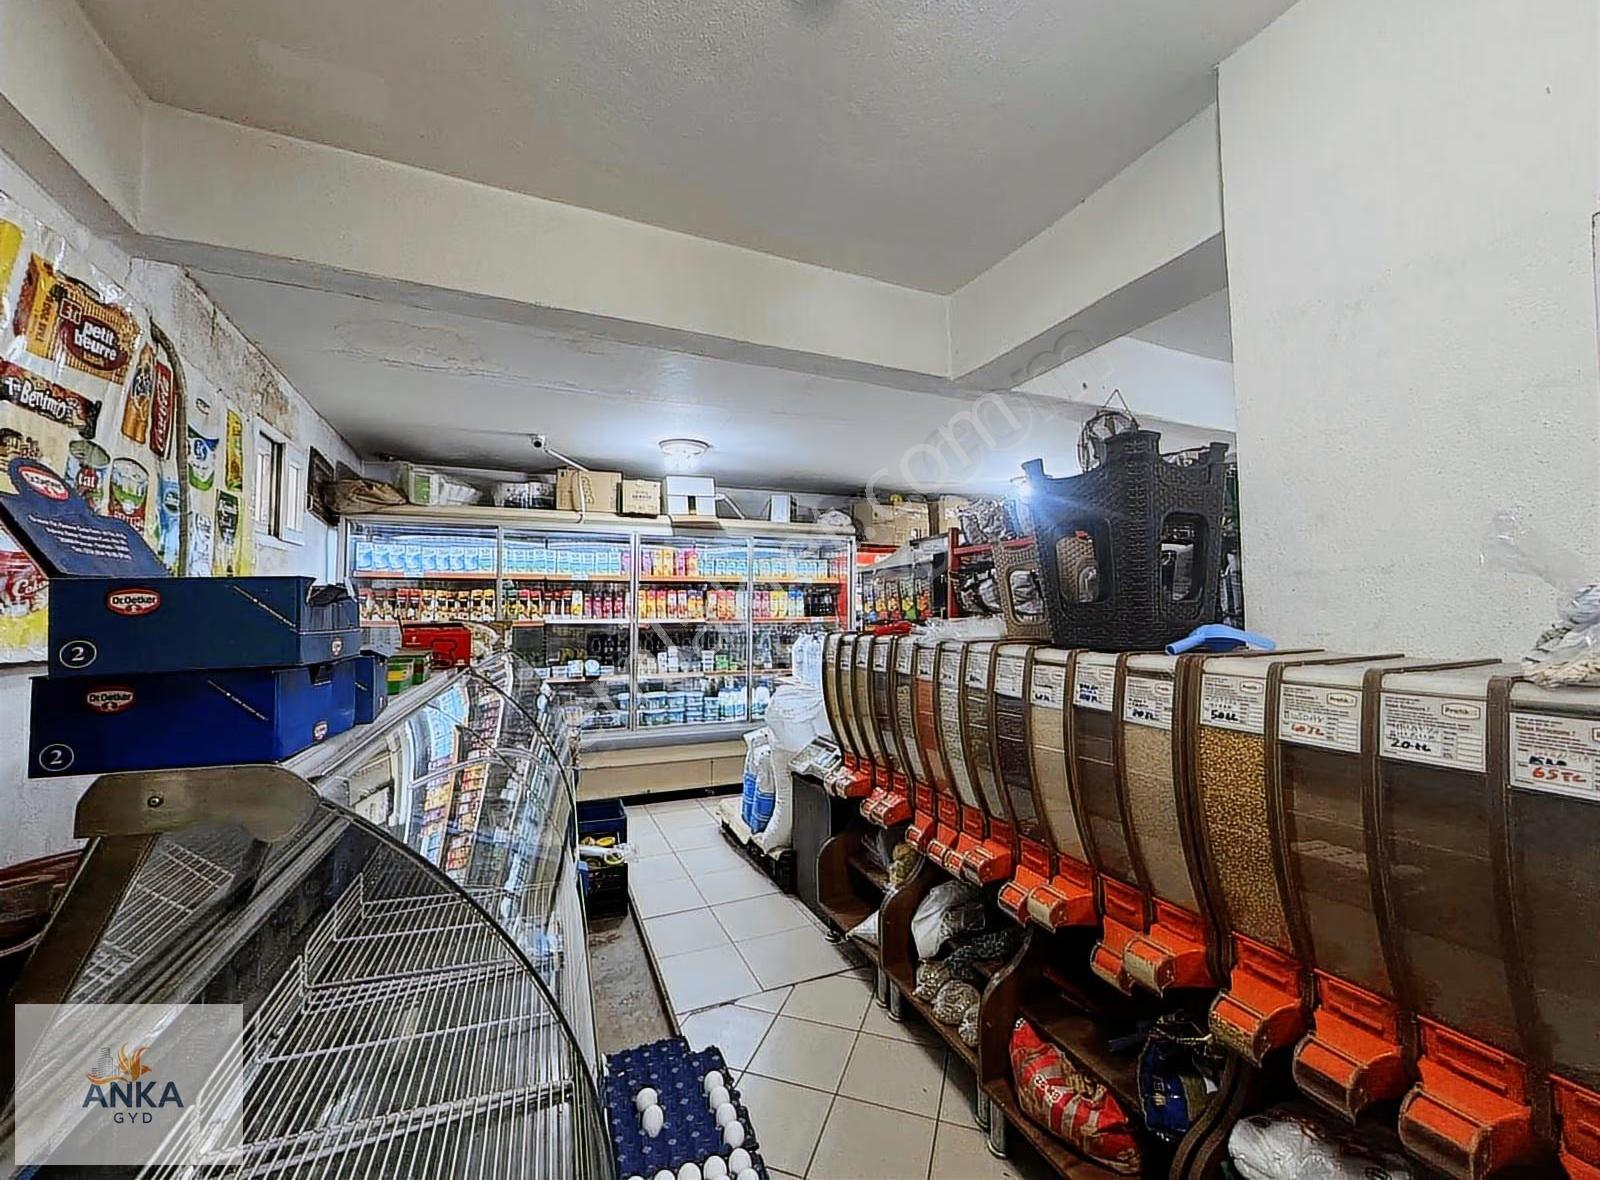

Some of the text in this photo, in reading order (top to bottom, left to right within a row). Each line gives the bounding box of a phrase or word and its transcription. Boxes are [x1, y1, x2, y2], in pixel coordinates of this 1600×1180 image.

[74, 325, 117, 361] beurre
[83, 321, 115, 346] petit
[71, 647, 85, 661] 2
[50, 750, 63, 763] 2
